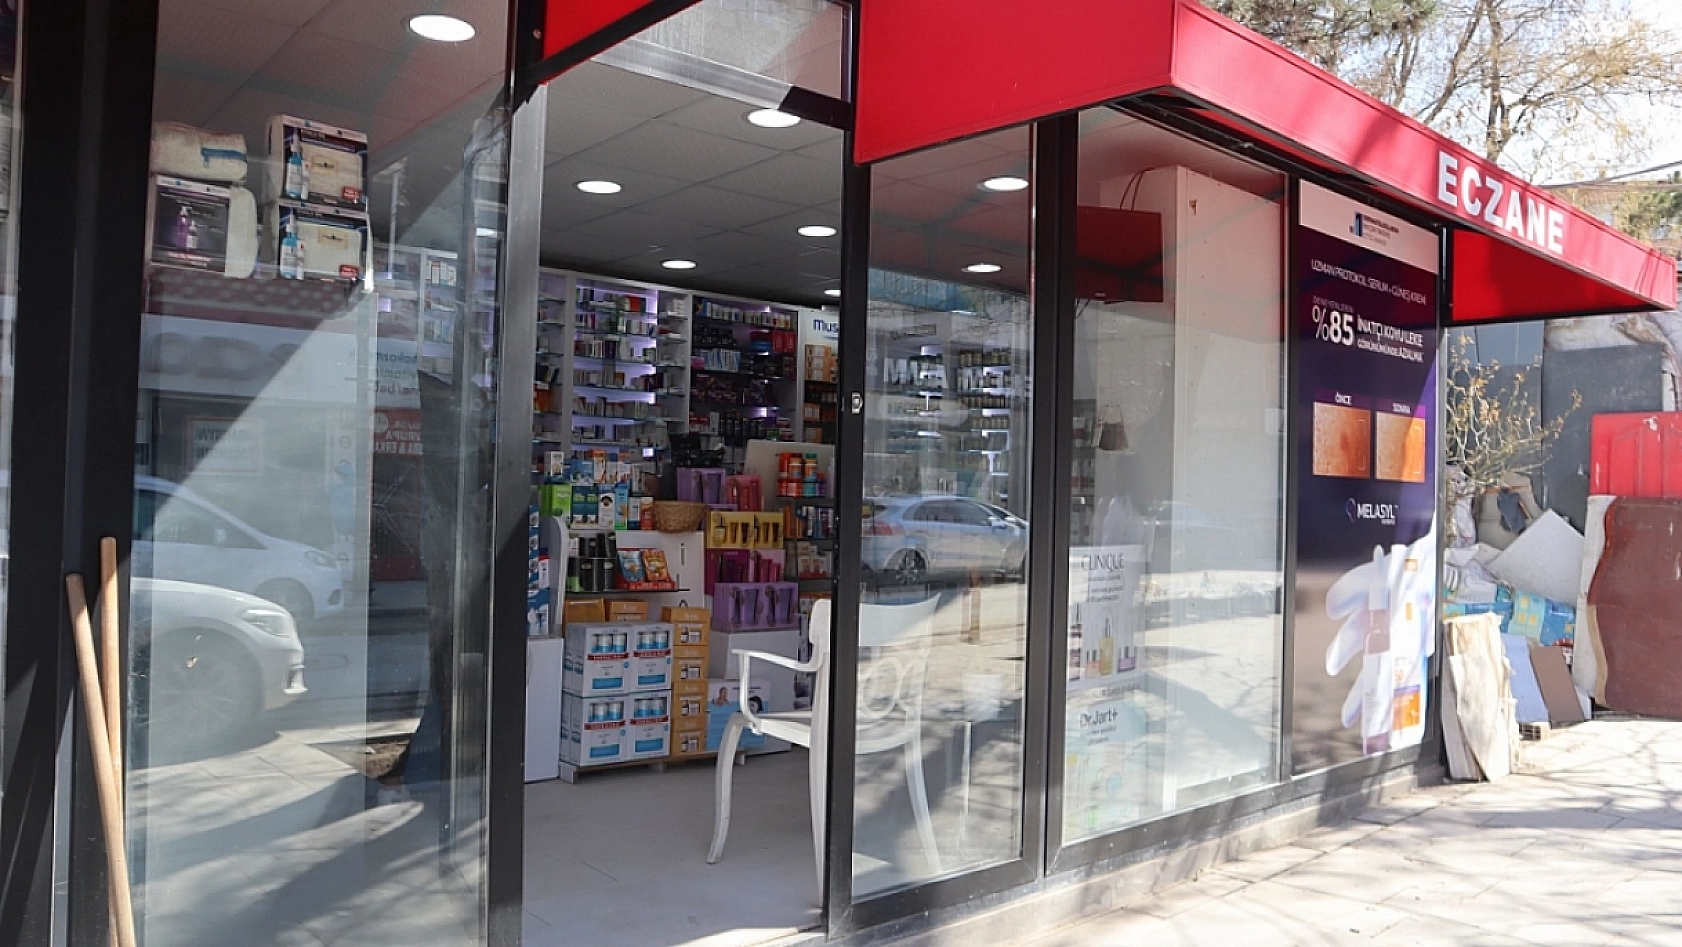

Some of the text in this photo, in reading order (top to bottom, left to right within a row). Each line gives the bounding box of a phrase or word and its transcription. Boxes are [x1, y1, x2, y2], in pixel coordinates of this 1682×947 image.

[1438, 150, 1563, 254] ECZANE
[1312, 304, 1354, 346] %85
[1404, 330, 1424, 348] LEKE
[1335, 391, 1353, 406] ÖNCE
[1357, 503, 1396, 519] MELASYL
[1081, 553, 1124, 573] CLINIQUE
